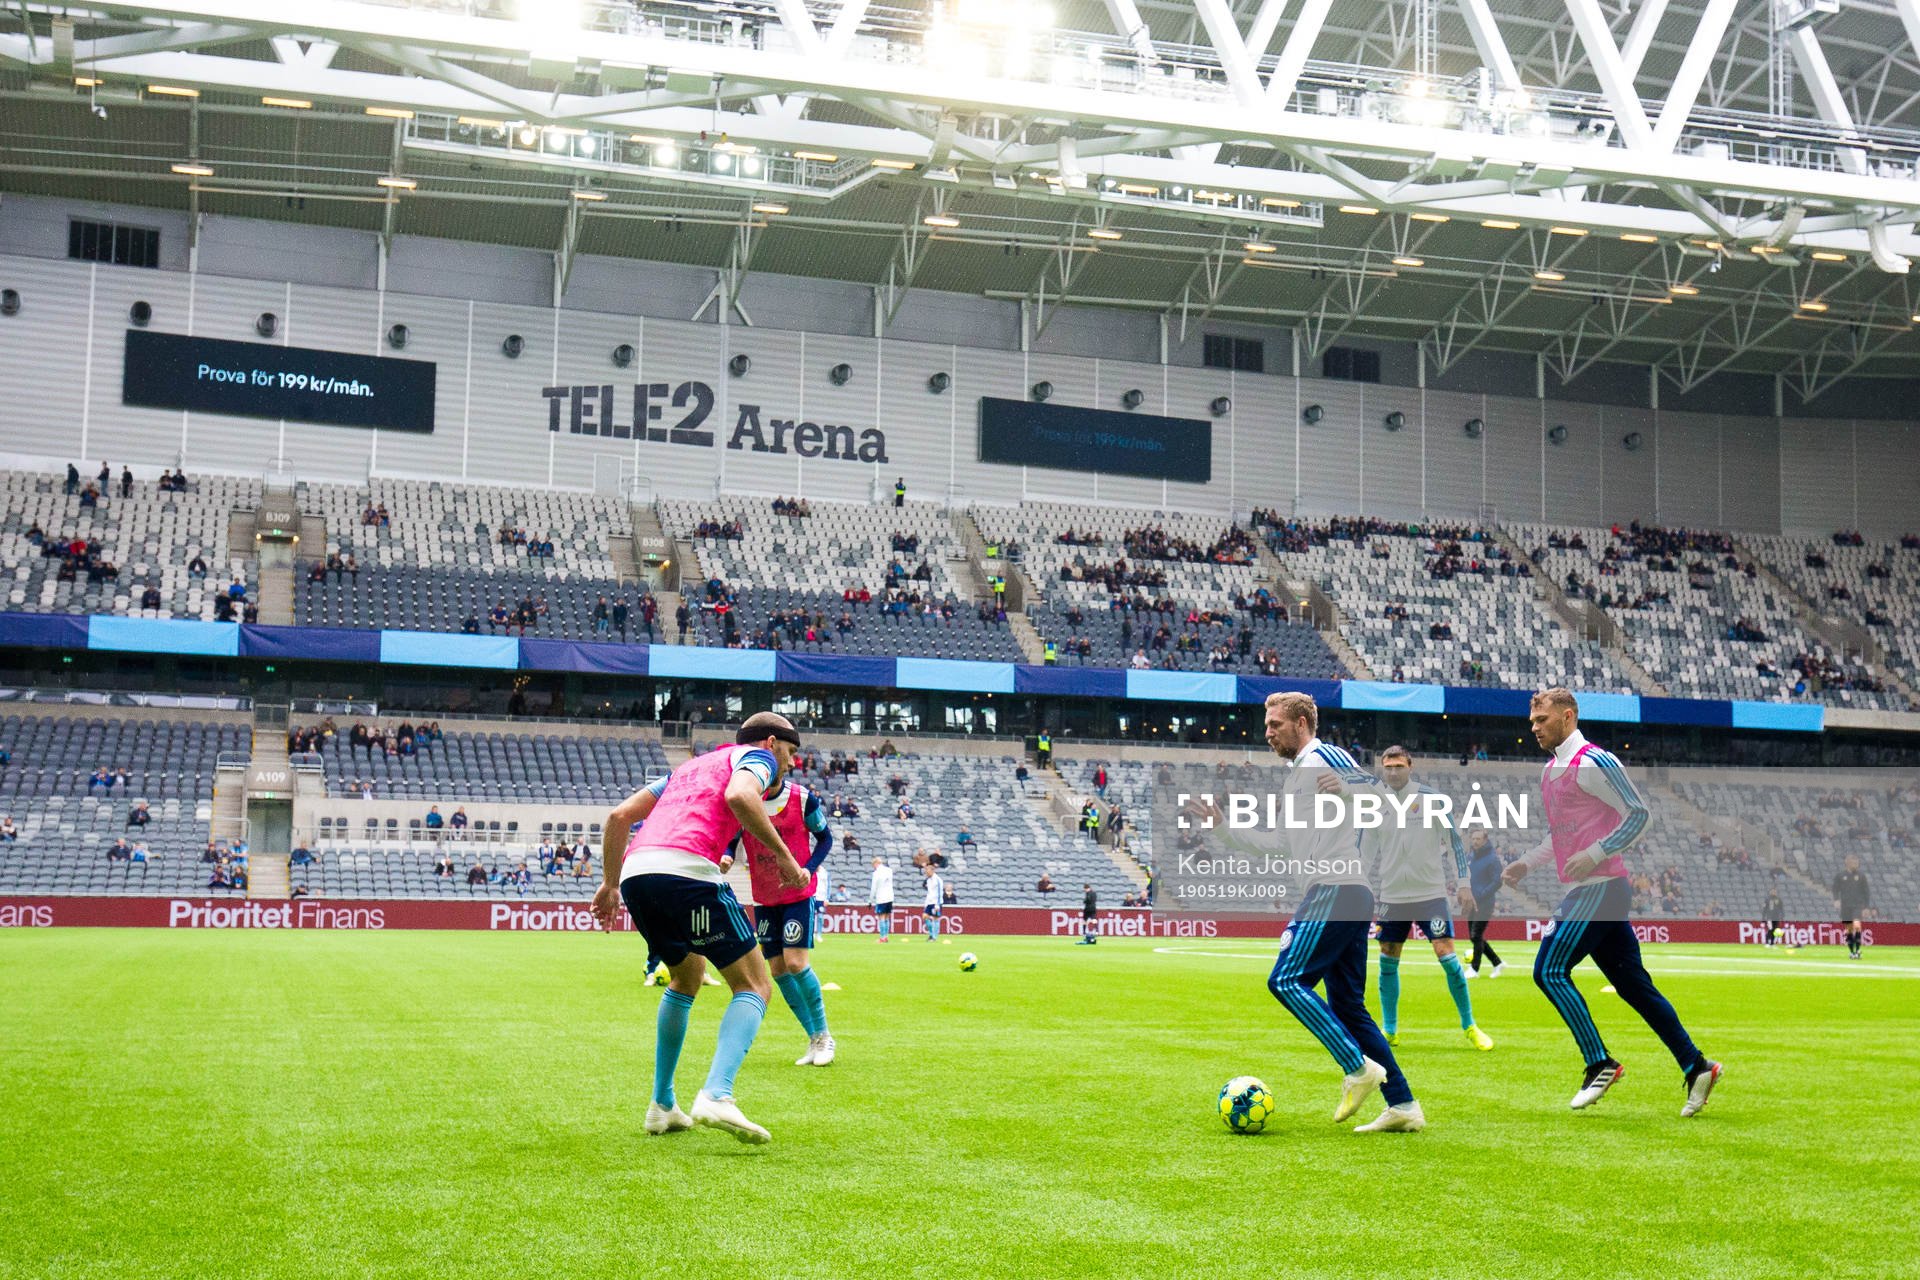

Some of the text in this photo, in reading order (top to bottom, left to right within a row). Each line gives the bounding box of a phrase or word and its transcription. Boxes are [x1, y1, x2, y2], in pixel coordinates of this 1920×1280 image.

[198, 363, 375, 397] Prova för 199 kr/mån.
[541, 380, 889, 463] TELE2 Arena
[266, 511, 290, 523] B109
[255, 771, 286, 782] A109
[169, 900, 385, 929] Prioritet Finans
[1150, 912, 1217, 937] Finans
[1739, 922, 1817, 945] Priitet
